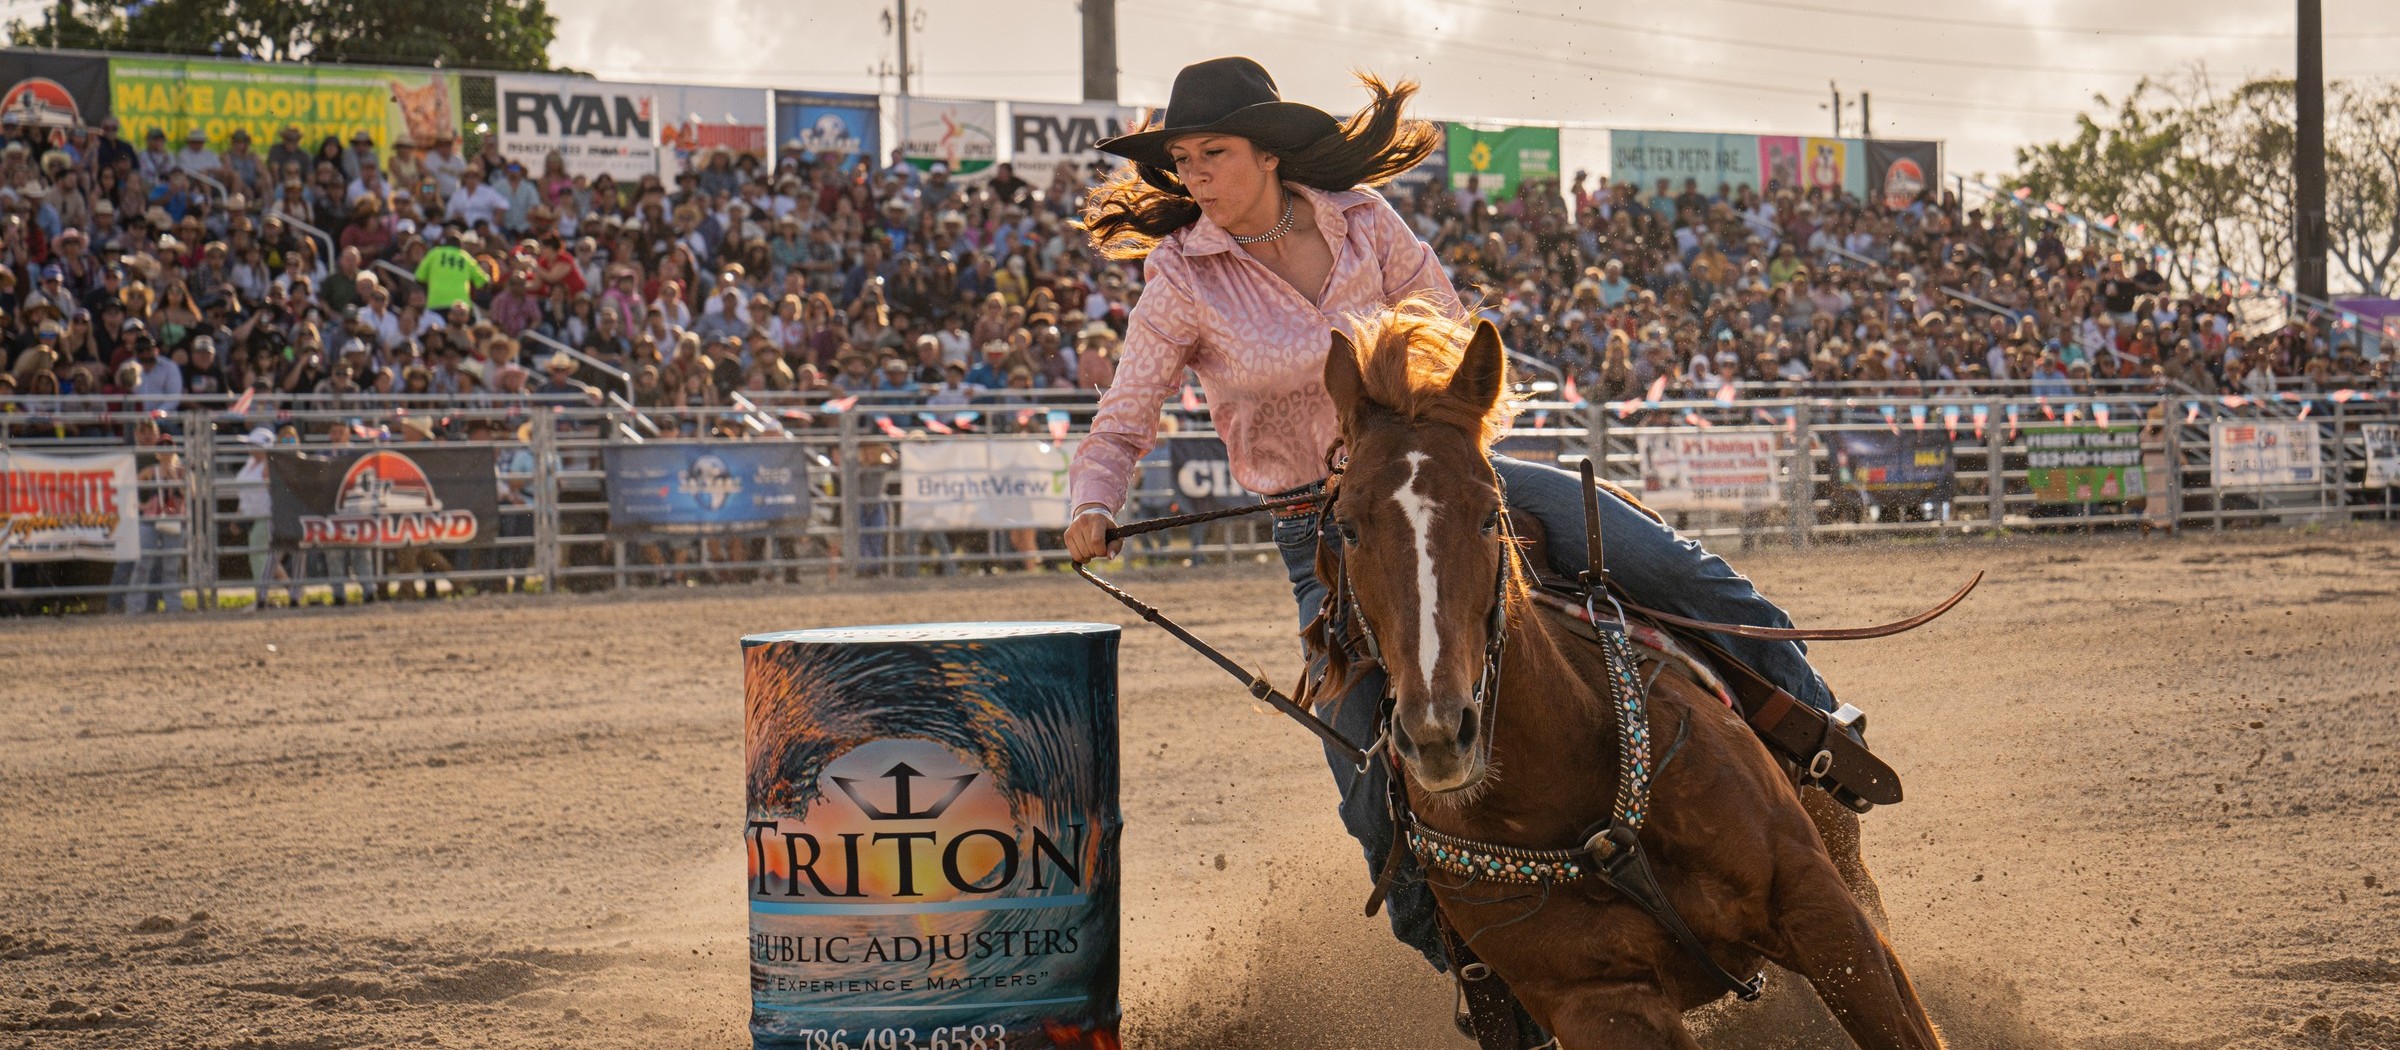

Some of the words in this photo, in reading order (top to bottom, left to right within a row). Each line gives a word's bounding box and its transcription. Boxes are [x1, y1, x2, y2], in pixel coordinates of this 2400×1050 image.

[117, 83, 214, 113] MAKE
[222, 88, 387, 121] ADOPTION
[505, 91, 649, 138] RYAN
[1616, 146, 1673, 171] SHELTER
[1677, 148, 1711, 172] PETS
[0, 469, 118, 514] WNRITE
[917, 475, 1048, 498] BrightView
[302, 509, 476, 547] REDLAND
[749, 820, 1084, 897] TRITON
[756, 933, 851, 965] PUBLIC
[862, 926, 1080, 970] ADJUSTERS
[799, 1022, 1006, 1050] 786-493-6583
